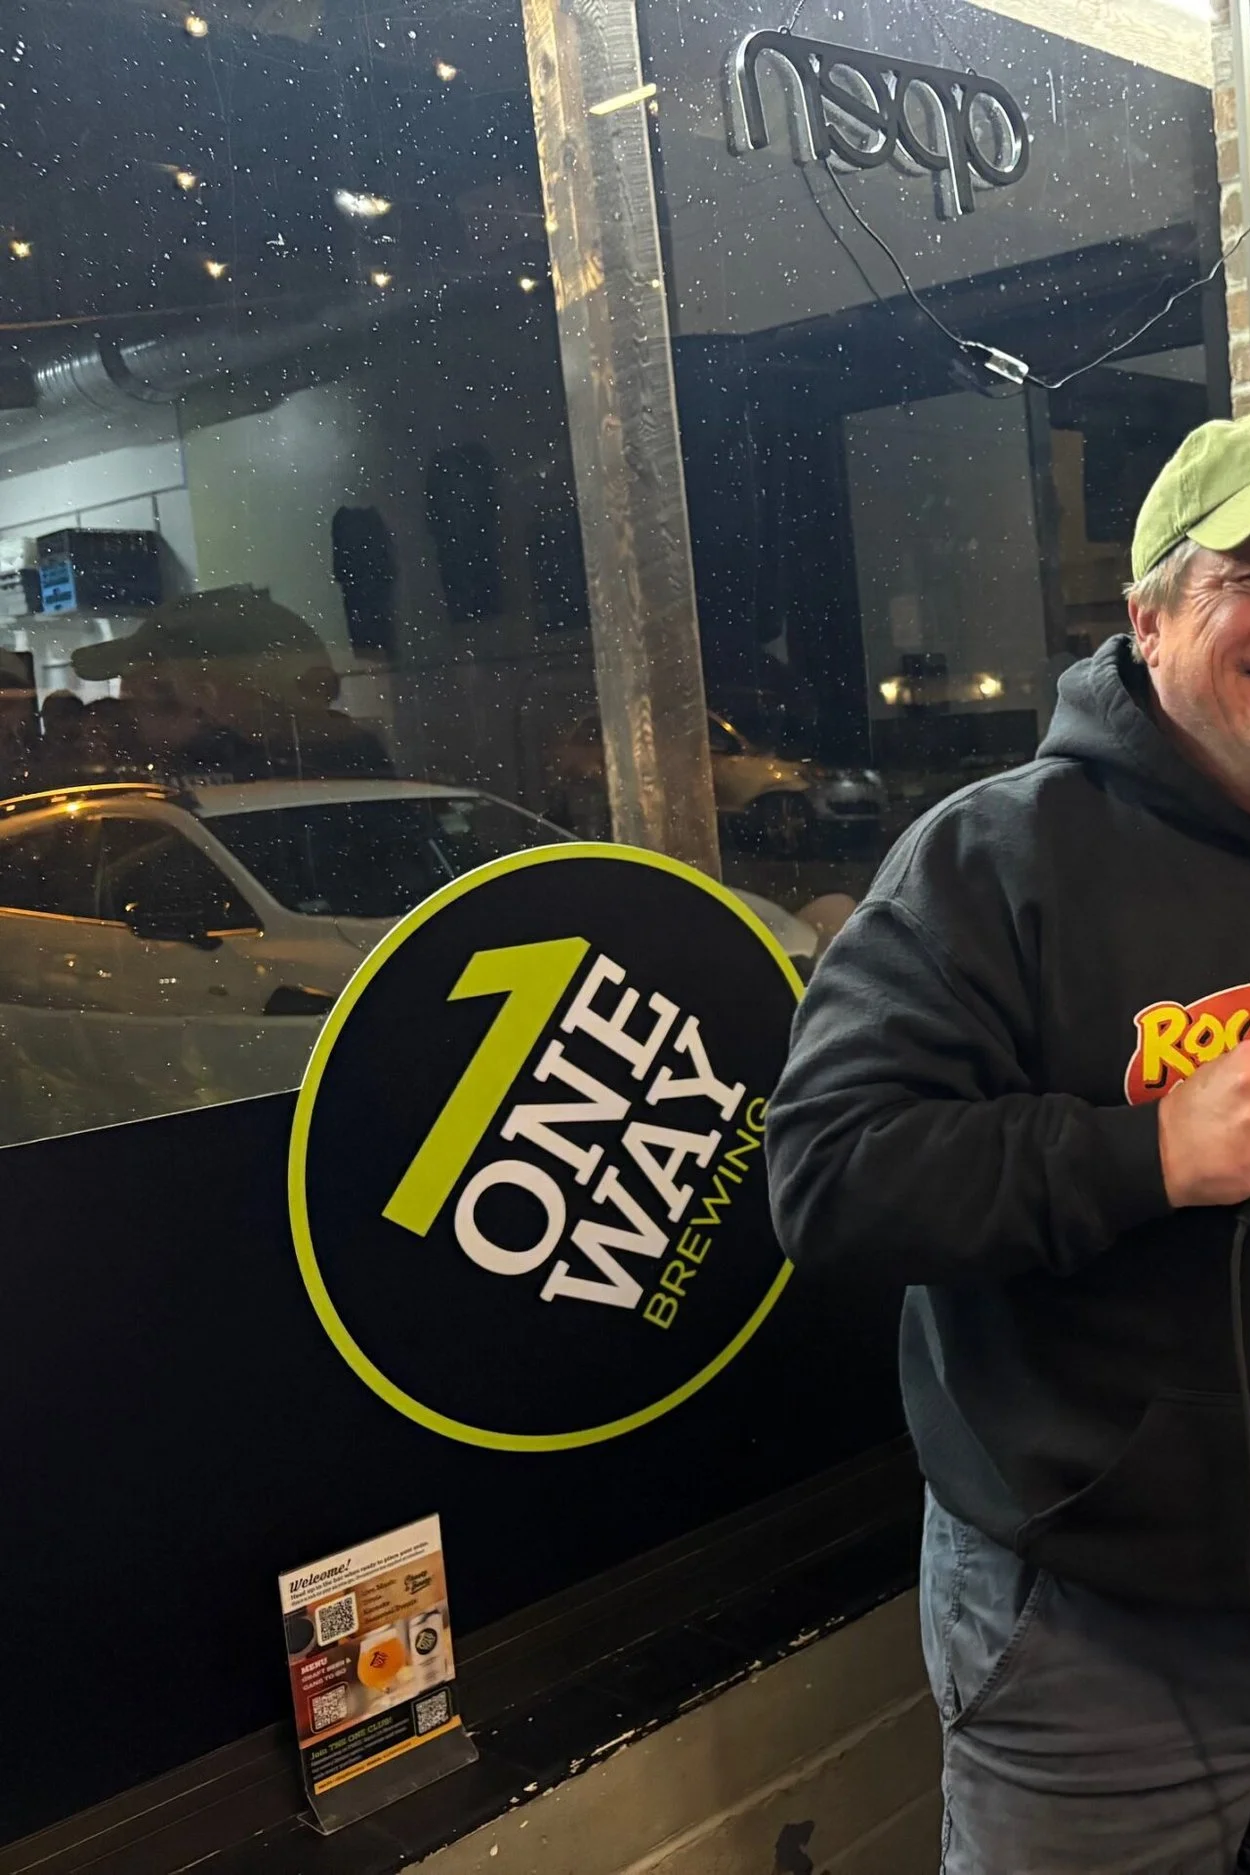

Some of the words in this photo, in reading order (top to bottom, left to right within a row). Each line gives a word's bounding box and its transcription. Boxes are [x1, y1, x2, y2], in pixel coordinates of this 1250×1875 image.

[381, 936, 592, 1238] 1
[454, 953, 681, 1276] ONE
[539, 1016, 747, 1310] WAY
[643, 1097, 770, 1329] BREWING
[289, 1559, 352, 1593] Welcome!
[301, 1657, 328, 1675] MENU
[311, 1748, 328, 1760] Join
[348, 1729, 366, 1743] ONE
